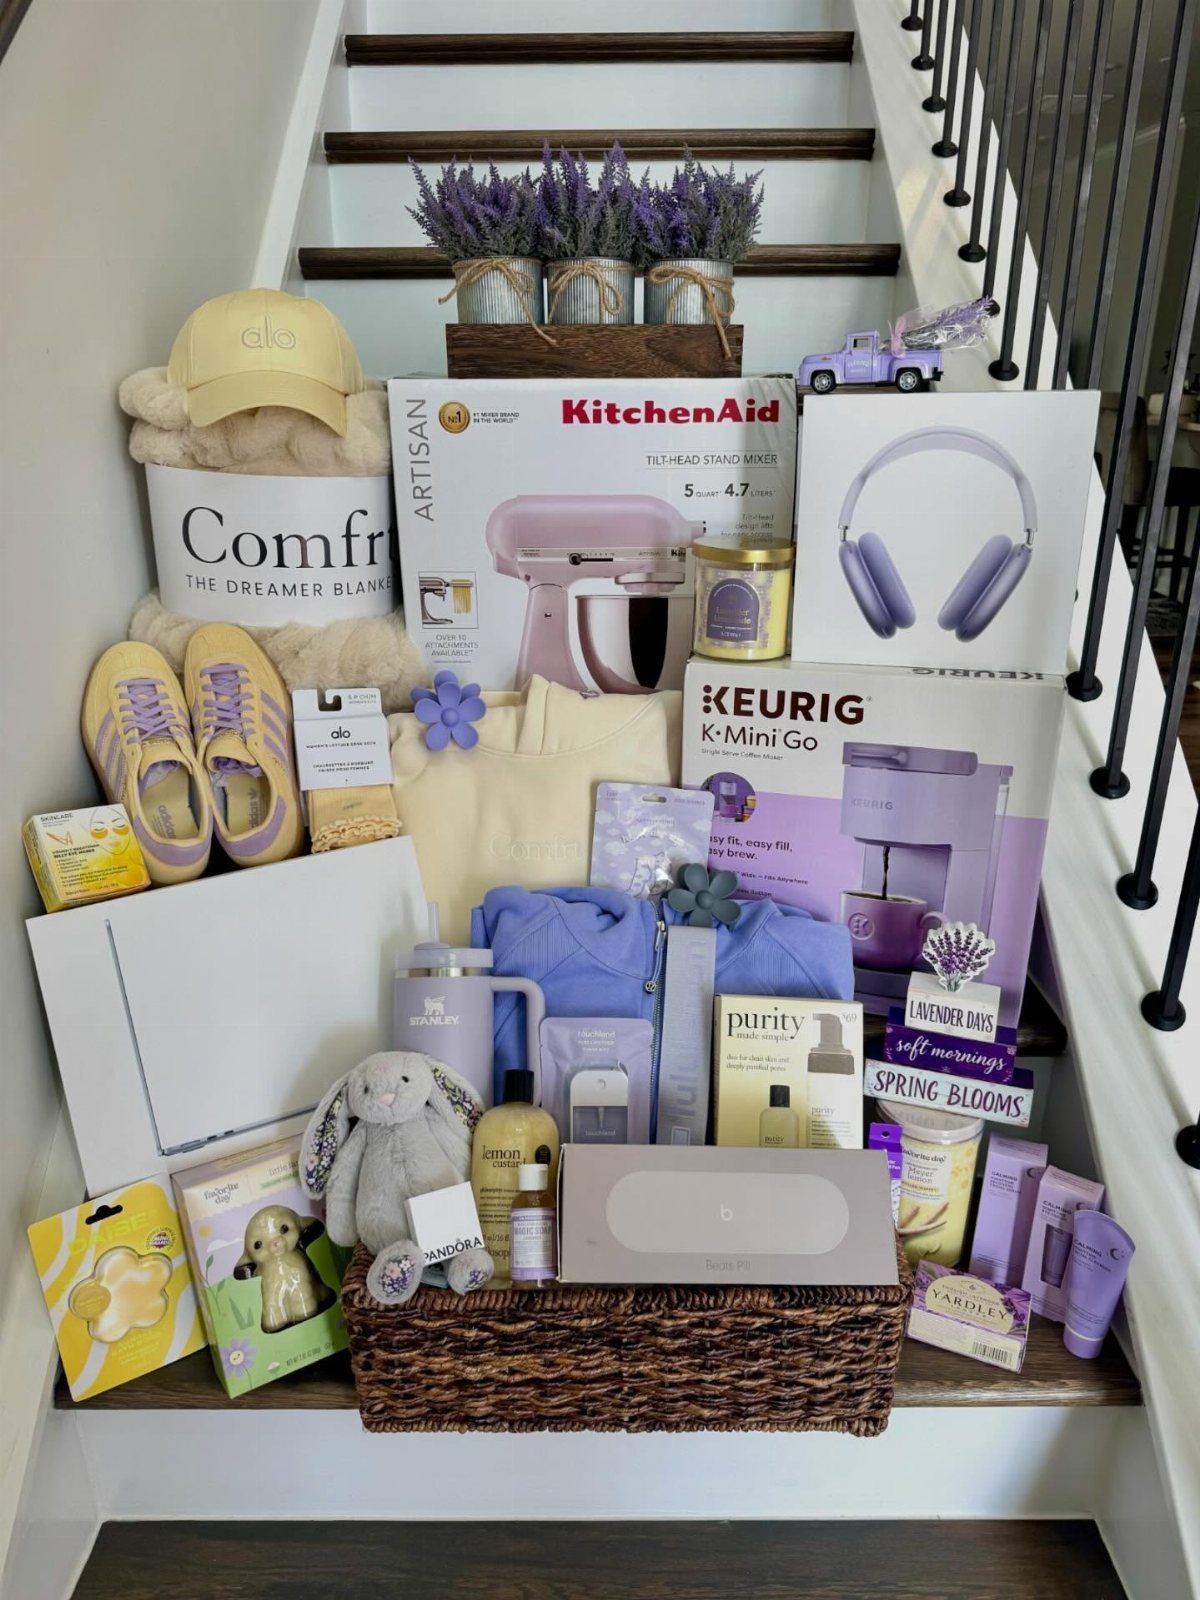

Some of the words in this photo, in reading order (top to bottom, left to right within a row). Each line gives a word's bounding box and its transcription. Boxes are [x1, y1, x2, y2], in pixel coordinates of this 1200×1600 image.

[241, 314, 297, 350] alo
[562, 398, 780, 425] KitchenAid
[406, 399, 434, 522] ARTISAN
[646, 454, 700, 466] TILT-HEAD
[703, 454, 741, 465] STAND
[743, 453, 778, 465] MIXER
[683, 483, 694, 498] 5
[724, 482, 750, 497] 4.7
[186, 573, 217, 592] THE
[226, 579, 323, 598] DREAMER
[425, 641, 479, 649] ATTACHMENTS
[912, 668, 1044, 680] KEURIG
[331, 726, 351, 739] alo
[783, 730, 818, 751] Go
[727, 835, 743, 847] fit,
[746, 840, 773, 851] easy
[775, 841, 793, 852] fill,
[727, 849, 758, 860] brew.
[408, 1015, 460, 1026] STANLEY
[727, 1006, 806, 1040] purity
[909, 1000, 963, 1027] LAVENDER
[966, 1010, 994, 1033] DAYS
[736, 1031, 759, 1040] made
[761, 1032, 790, 1043] simple
[896, 1035, 932, 1061] soft
[930, 1050, 1007, 1075] mornings
[873, 1070, 939, 1101] SPRING
[946, 1083, 1024, 1118] BLOOMS
[482, 1145, 521, 1160] lemon
[907, 1170, 933, 1184] lemon
[908, 1166, 934, 1178] Meyer
[991, 1171, 1018, 1182] CALMING
[203, 1183, 239, 1200] favorite
[215, 1191, 232, 1204] day
[1042, 1200, 1072, 1215] CALMING
[535, 1226, 551, 1235] SOAP
[423, 1236, 483, 1261] PANDORA
[705, 1259, 734, 1271] Beats
[737, 1259, 751, 1271] Pill
[933, 1289, 1008, 1320] YARDLEY
